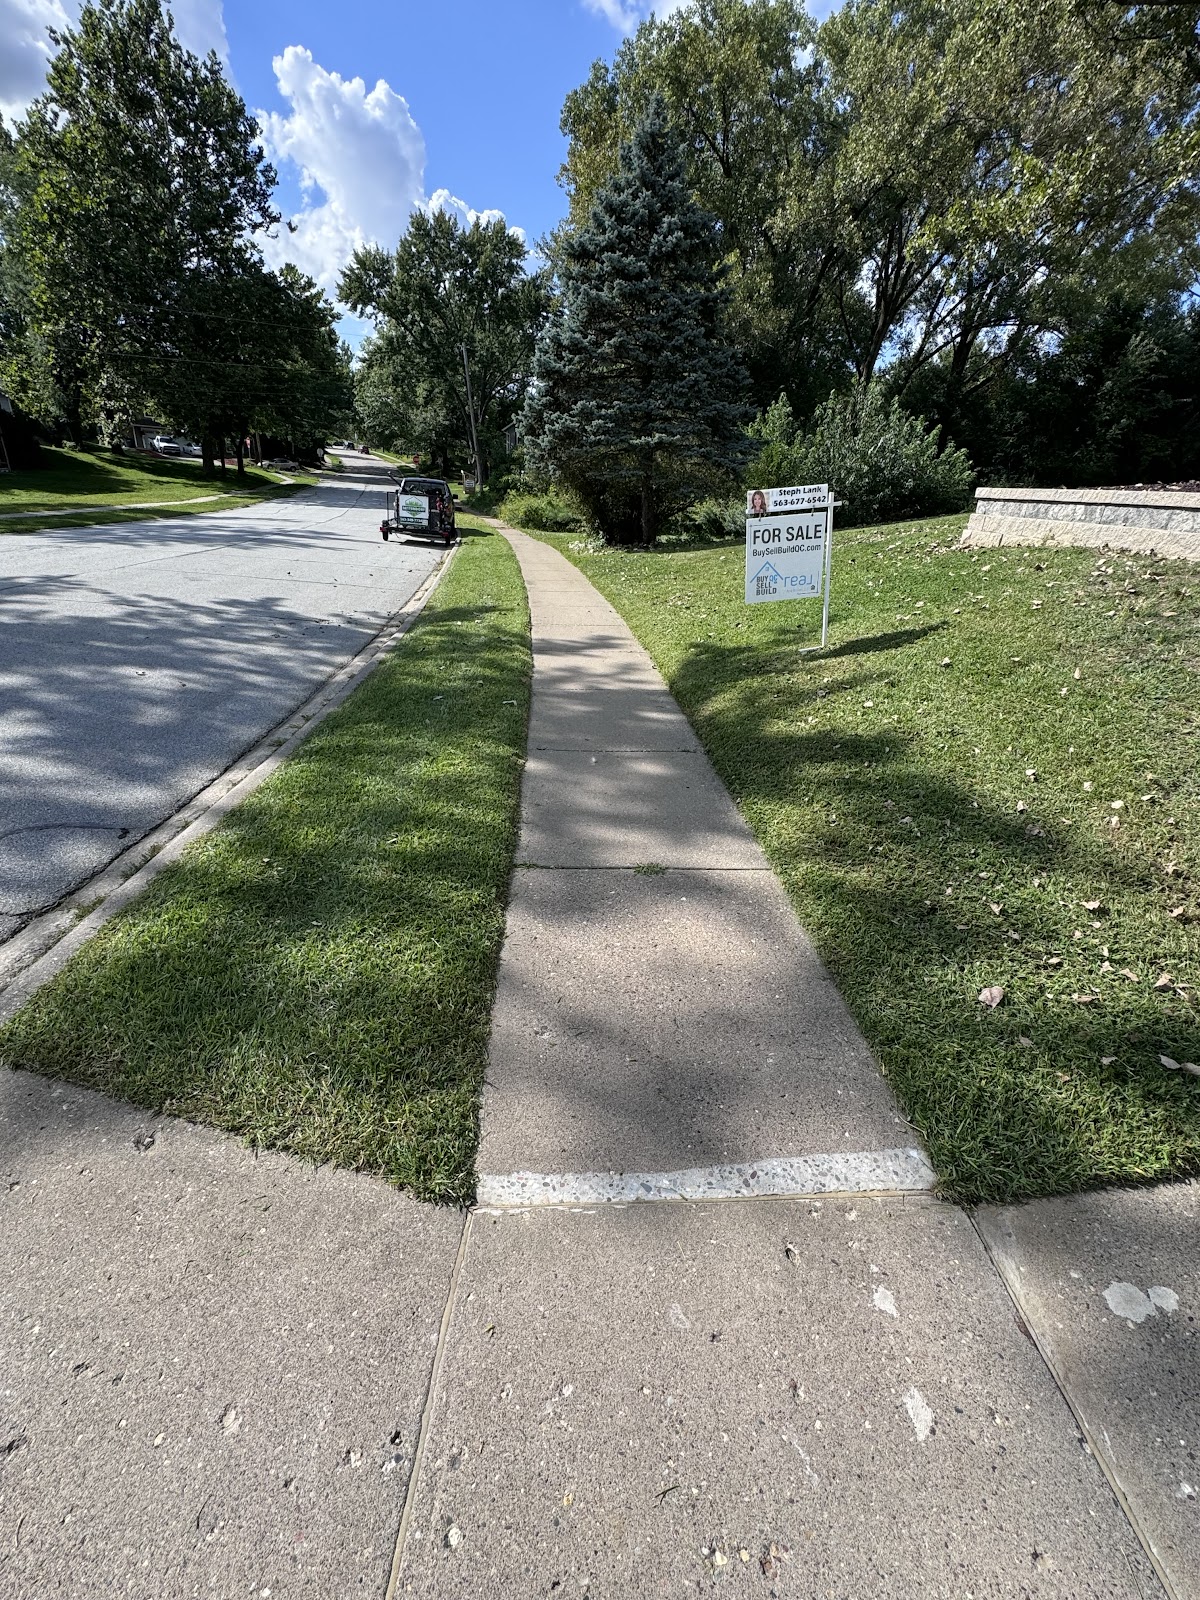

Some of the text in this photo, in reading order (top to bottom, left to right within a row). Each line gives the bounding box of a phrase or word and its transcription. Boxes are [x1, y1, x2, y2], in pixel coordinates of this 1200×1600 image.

[779, 486, 822, 497] Steph Lank
[774, 496, 826, 507] 563-677-6542
[753, 524, 823, 545] FOR SALE
[753, 545, 821, 557] BuySellBuildQC.com
[757, 588, 777, 596] BUILD
